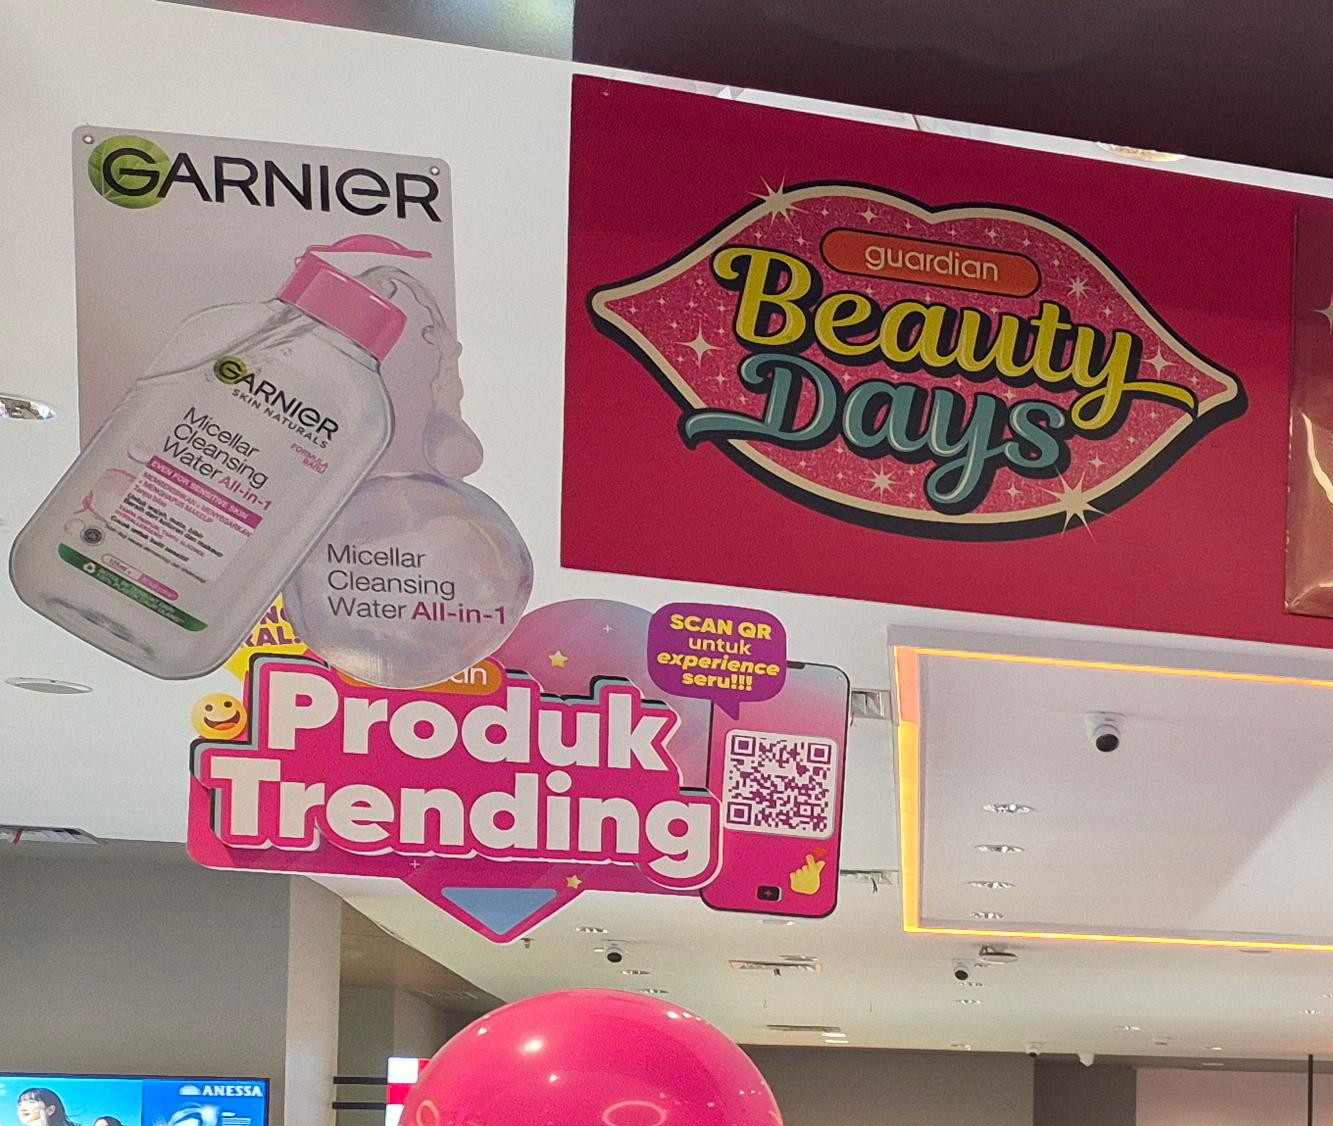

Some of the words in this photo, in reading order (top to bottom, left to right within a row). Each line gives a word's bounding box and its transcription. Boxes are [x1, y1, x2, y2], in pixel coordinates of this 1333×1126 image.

[101, 146, 443, 223] GARNIER
[864, 243, 999, 282] guardian
[711, 247, 1195, 431] Beauty
[218, 360, 339, 441] GARNIER
[231, 388, 261, 410] SKIN
[264, 404, 329, 450] NATURALS
[182, 406, 261, 457] Micellar
[686, 353, 1067, 503] Days
[163, 436, 223, 480] Water
[221, 473, 273, 511] All-in-1
[173, 423, 269, 490] Cleansing
[327, 543, 427, 570] Micellar
[327, 570, 456, 600] Cleansing
[327, 597, 407, 622] Water
[411, 600, 506, 627] All-in-1
[670, 613, 732, 637] SCAN
[737, 621, 772, 642] QR
[656, 651, 780, 678] experience
[688, 637, 752, 655] untuk
[682, 670, 753, 693] seru!!!
[268, 671, 669, 772] Produk
[210, 756, 712, 879] Trending
[202, 1084, 263, 1098] ANESSA
